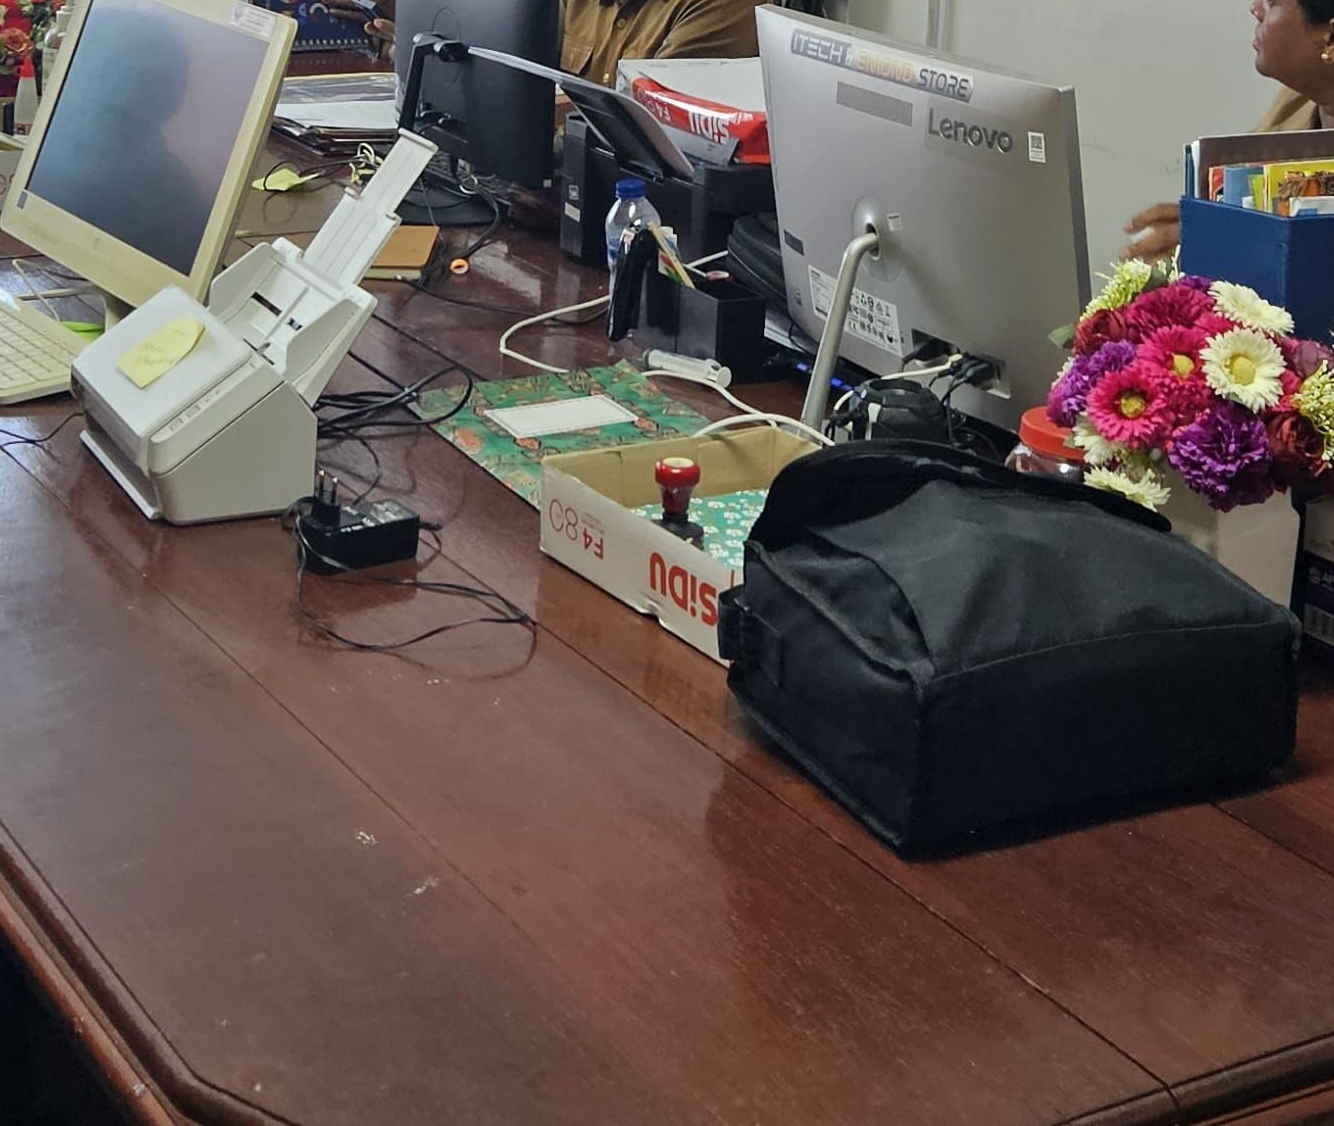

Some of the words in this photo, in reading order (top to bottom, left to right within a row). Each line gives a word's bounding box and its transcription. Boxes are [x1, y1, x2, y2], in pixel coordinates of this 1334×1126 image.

[793, 32, 844, 65] ITECH
[917, 67, 971, 99] STORE
[926, 107, 1014, 155] Lenovo
[582, 527, 604, 560] F4
